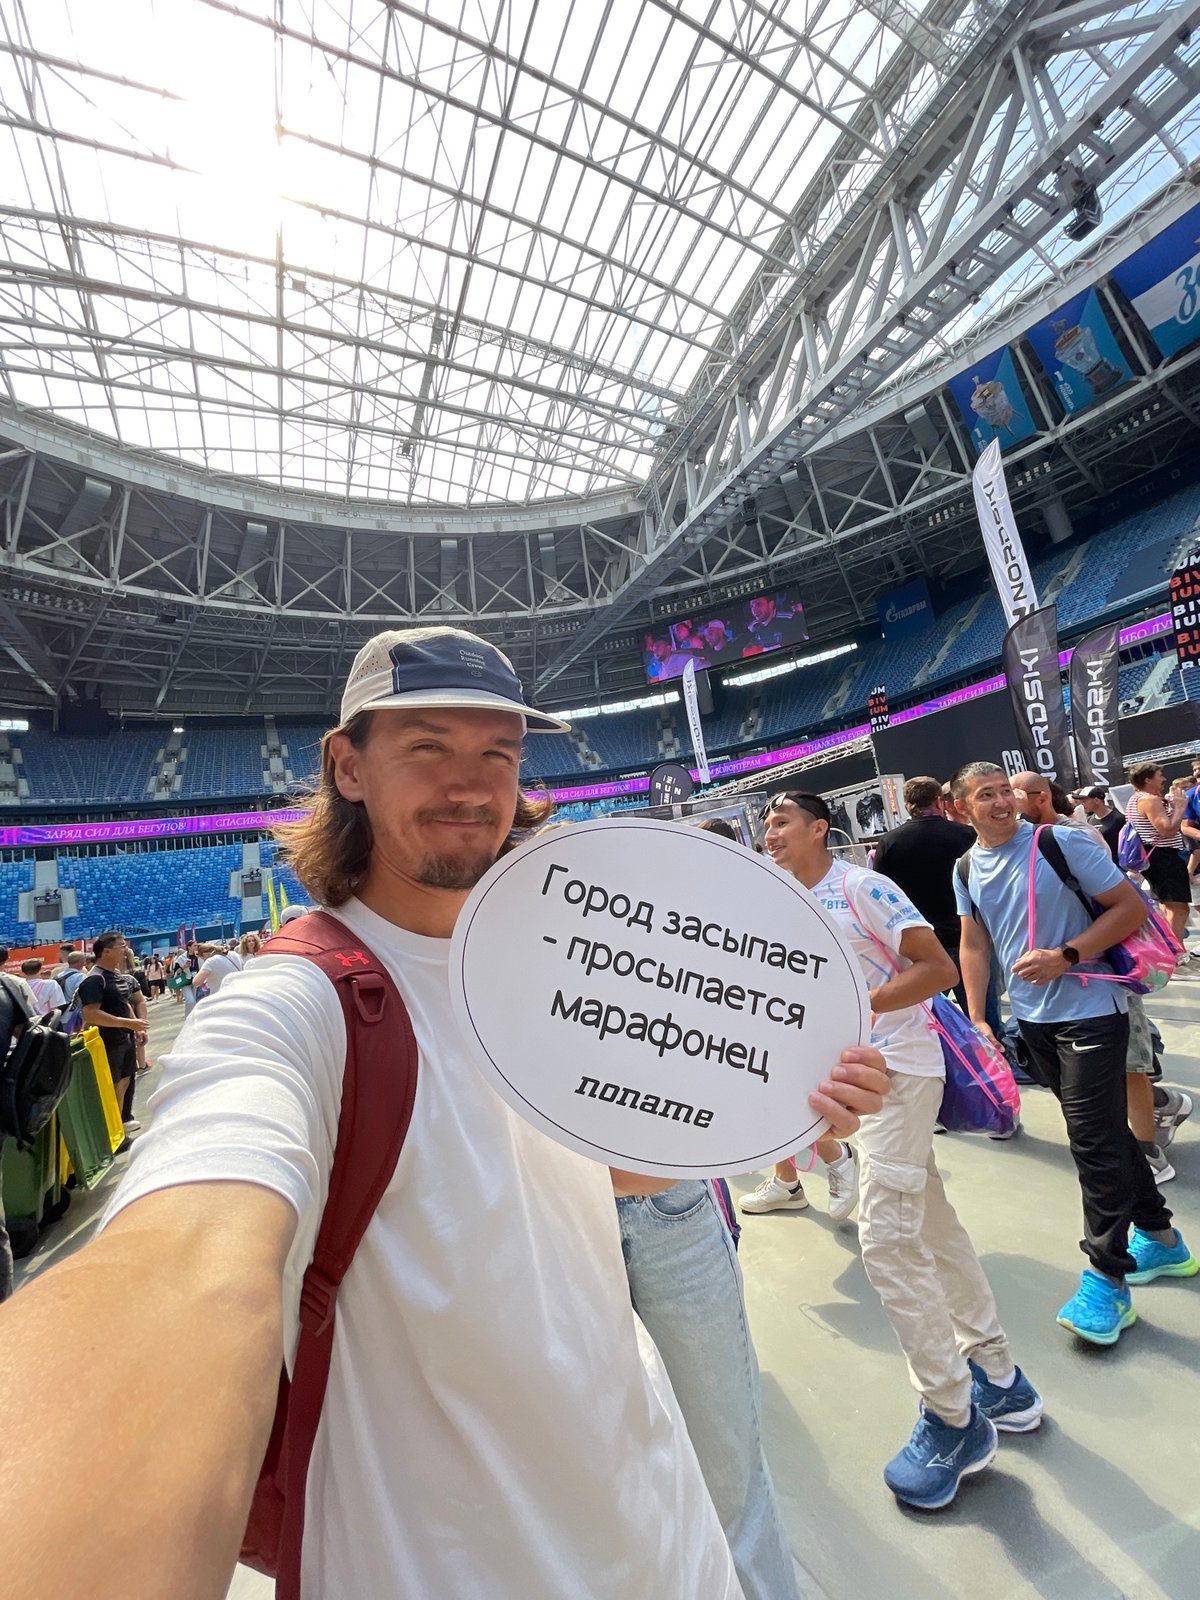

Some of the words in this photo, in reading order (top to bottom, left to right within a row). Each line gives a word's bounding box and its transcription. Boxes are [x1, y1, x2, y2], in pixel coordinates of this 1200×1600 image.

[983, 480, 1028, 602] NORDSKI
[1173, 599, 1200, 617] BI
[1175, 613, 1200, 630] IU
[1120, 628, 1148, 646] ИБО
[1177, 629, 1200, 645] BI
[1179, 643, 1200, 658] IU
[868, 696, 886, 707] BIV
[870, 704, 889, 715] IUM
[871, 714, 889, 725] BIV
[779, 746, 806, 760] SPECIAL
[807, 738, 836, 754] THANKS
[836, 735, 847, 745] TO
[848, 727, 870, 741] EVERY
[1002, 750, 1028, 777] CR
[655, 782, 682, 796] RUN
[44, 828, 82, 840] ЗАРЯД
[84, 826, 110, 839] СИЛ
[112, 825, 136, 837] ДЛЯ
[138, 821, 187, 834] БЕГУНОВ!
[215, 816, 263, 828] СПАСИБО
[826, 900, 849, 910] ВТБ
[542, 863, 654, 934] Город
[662, 911, 828, 979] засыпает
[566, 936, 806, 1030] просыпается
[550, 989, 769, 1084] марафонец
[574, 1075, 715, 1129] noname
